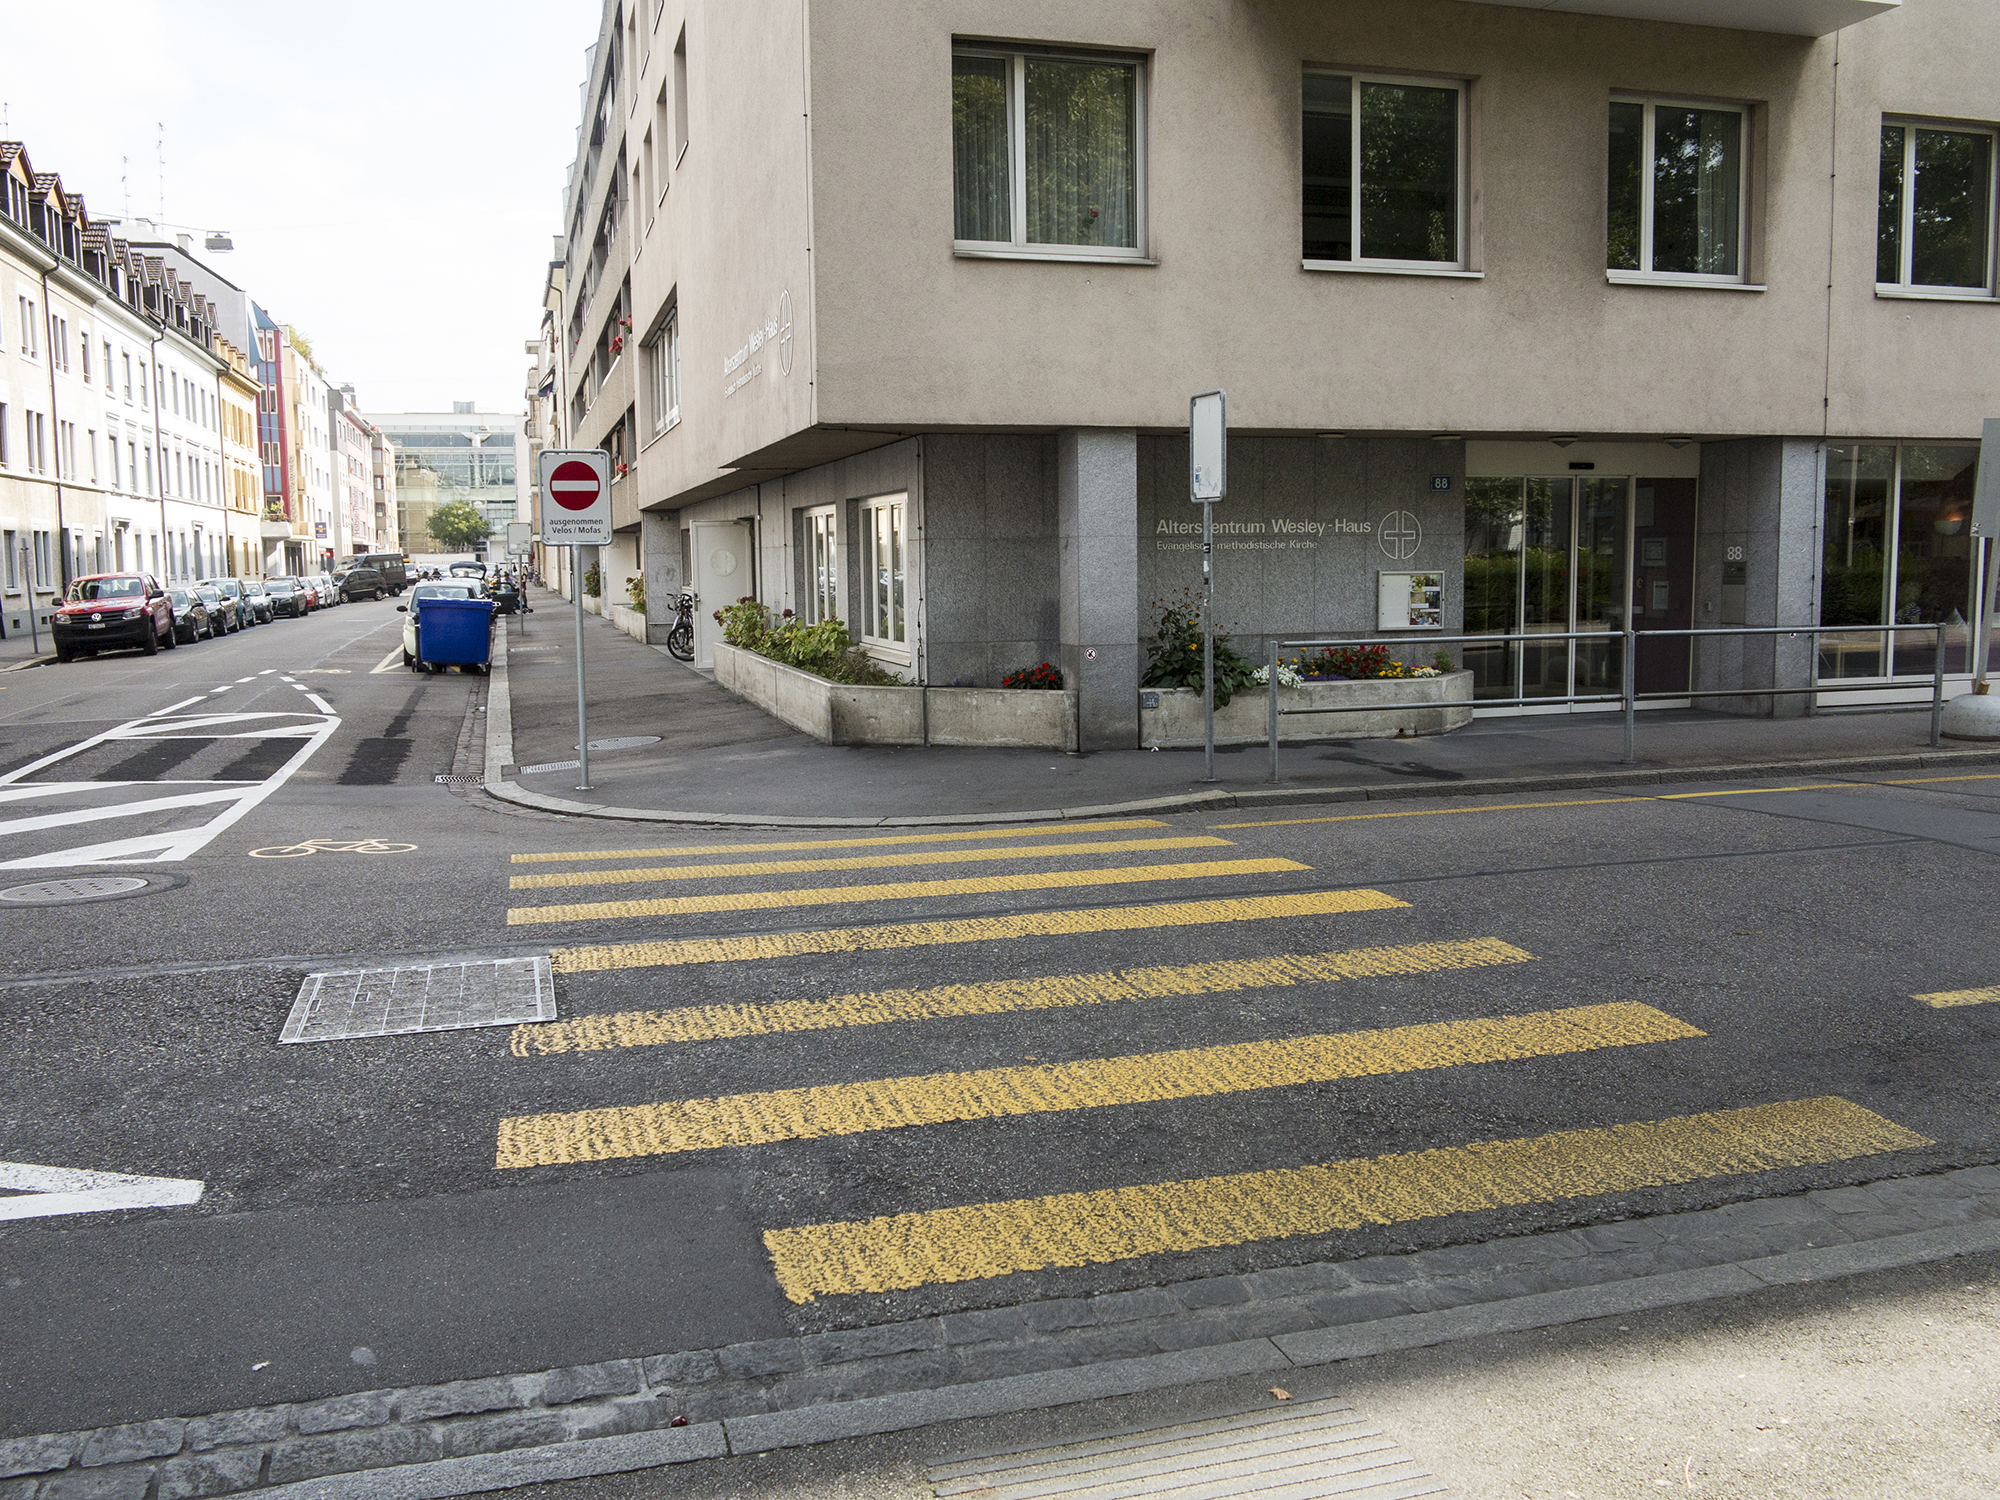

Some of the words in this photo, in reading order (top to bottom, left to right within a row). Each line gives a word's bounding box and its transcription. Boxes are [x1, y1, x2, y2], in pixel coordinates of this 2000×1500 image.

[1435, 477, 1448, 489] 88
[549, 518, 604, 527] ausgenommen
[1156, 519, 1266, 534] Altersentrum
[551, 526, 572, 534] Velos
[578, 526, 602, 534] Mofas
[1289, 539, 1318, 549] Kirche
[1727, 546, 1743, 560] 88
